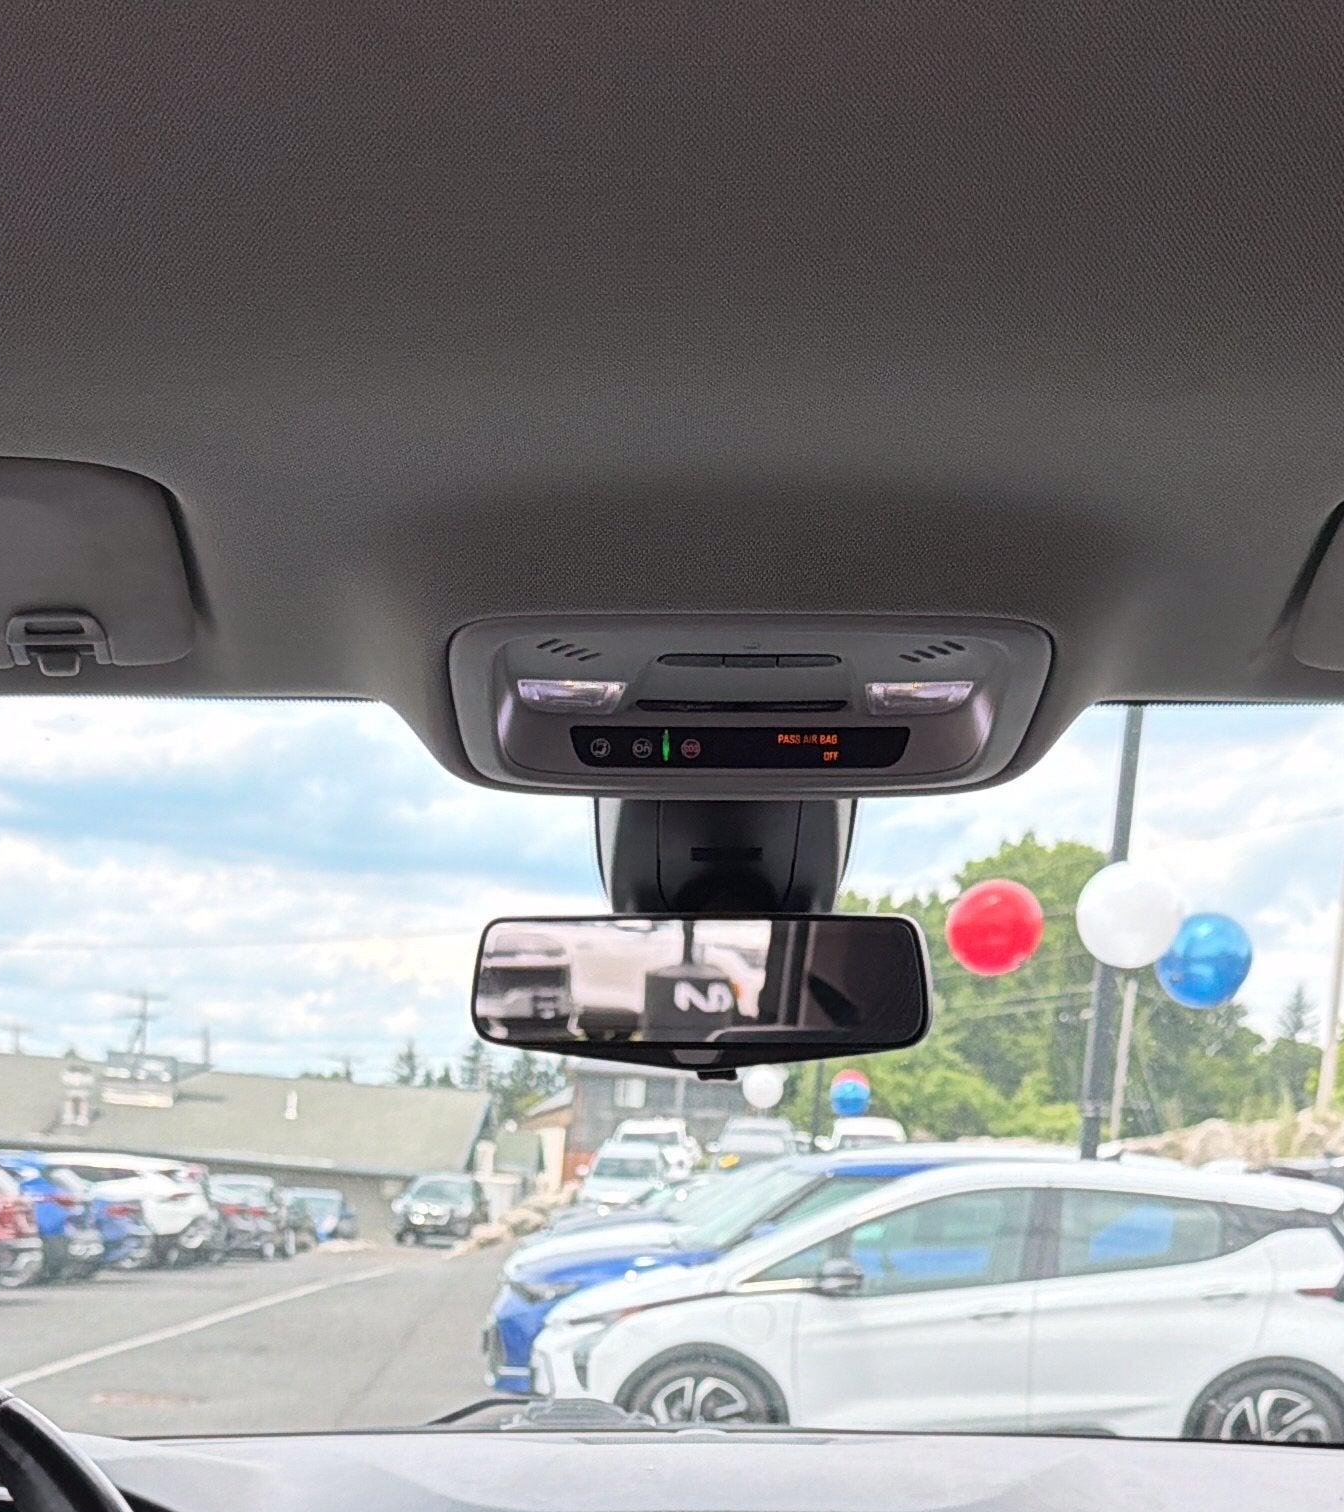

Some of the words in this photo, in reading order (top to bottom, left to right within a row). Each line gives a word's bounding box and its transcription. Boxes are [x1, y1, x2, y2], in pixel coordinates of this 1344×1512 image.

[778, 734, 801, 744] PASS
[803, 734, 817, 744] AIR
[820, 734, 838, 744] BAG
[823, 751, 839, 761] OFF
